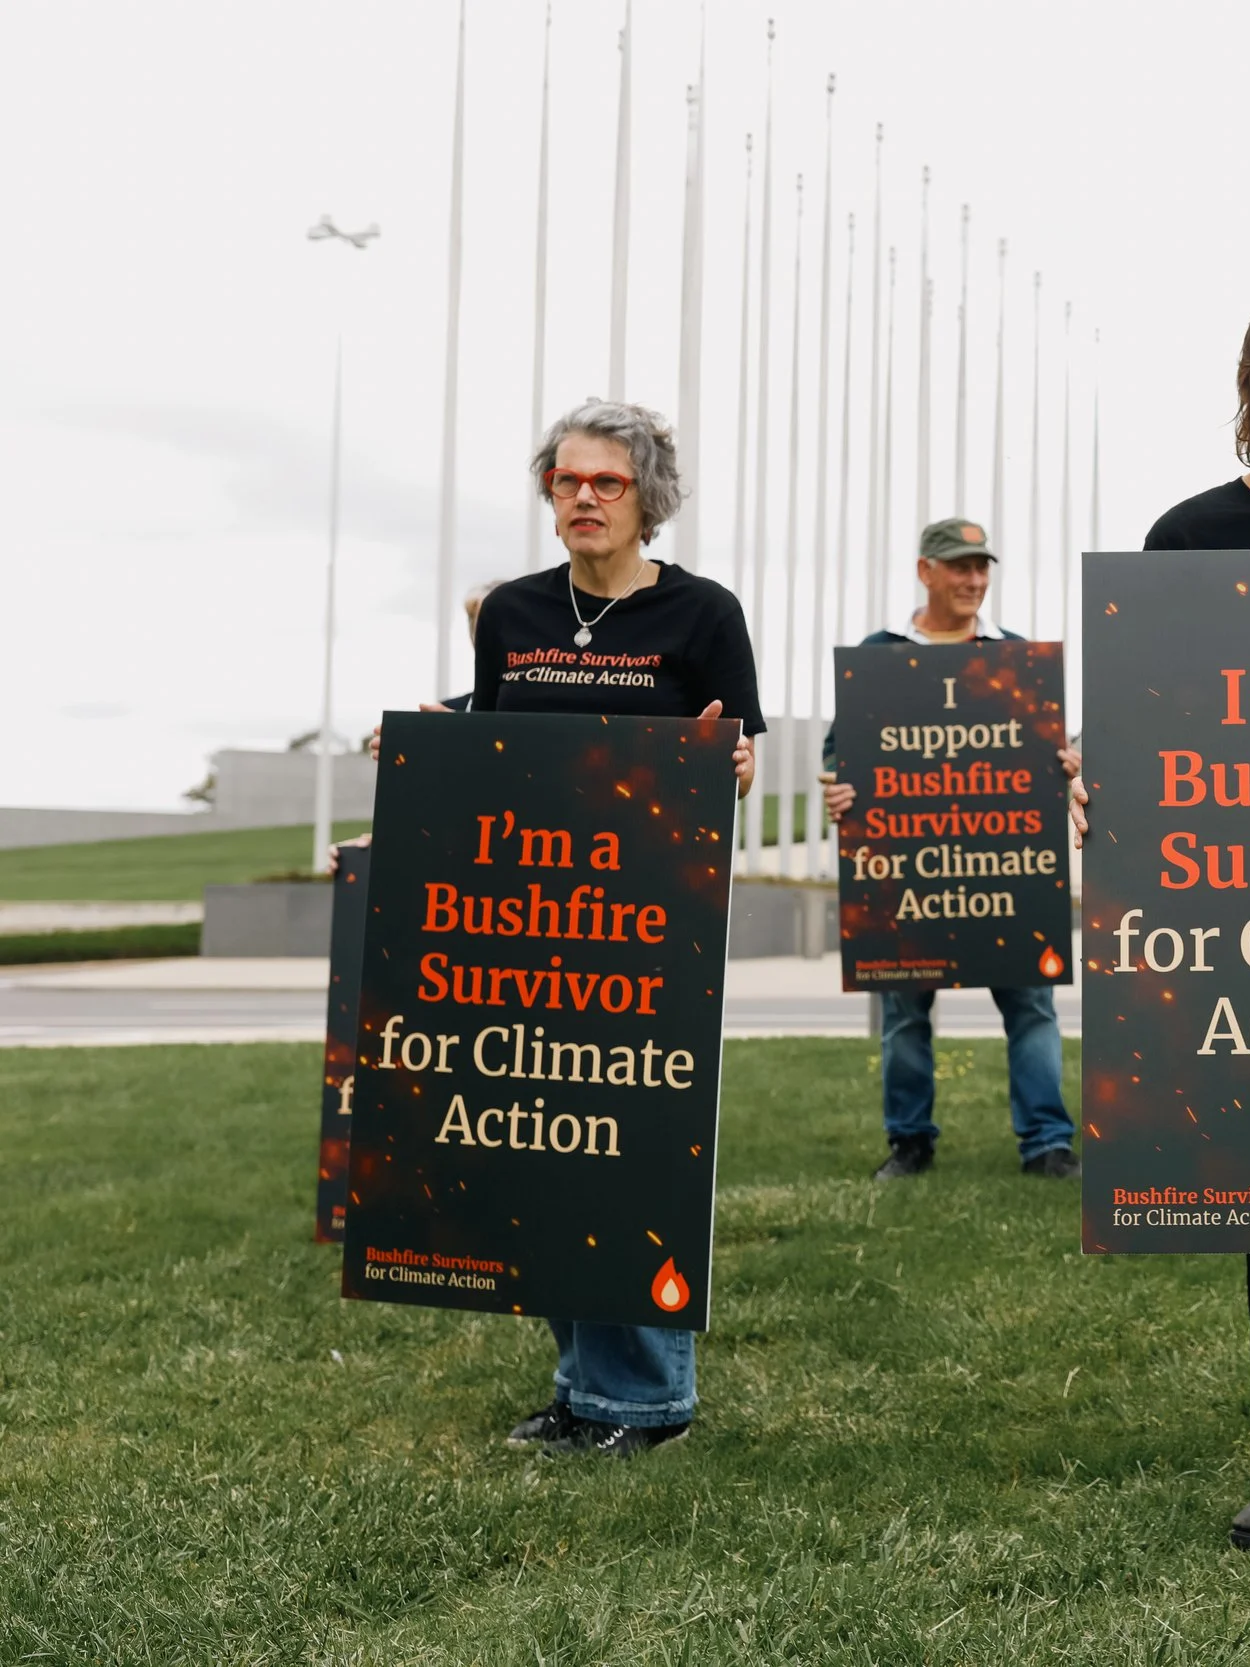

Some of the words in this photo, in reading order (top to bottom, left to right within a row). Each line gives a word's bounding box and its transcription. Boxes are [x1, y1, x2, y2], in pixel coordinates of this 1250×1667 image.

[508, 648, 576, 668] Bushfire
[579, 652, 662, 667] Survivors
[502, 670, 525, 682] or
[526, 667, 594, 684] Climate
[596, 671, 654, 687] Action
[944, 678, 956, 708] I
[881, 719, 1022, 758] support
[875, 762, 1031, 798] Bushfire
[865, 804, 1042, 838] Survivors
[475, 811, 573, 868] I’m
[590, 832, 620, 870] a
[854, 846, 907, 880] for
[916, 844, 1056, 878] Climate
[423, 883, 666, 943] Bushfire
[896, 886, 1014, 919] Action
[1113, 909, 1219, 972] for
[418, 953, 663, 1014] Survivor
[379, 1015, 459, 1072] for
[474, 1024, 694, 1089] Climate
[435, 1095, 620, 1156] Action
[1114, 1187, 1198, 1205] Bushfire
[1113, 1209, 1141, 1225] for
[1147, 1209, 1221, 1225] Climate
[366, 1247, 428, 1266] Bushfire
[432, 1254, 504, 1272] Survivors
[366, 1263, 386, 1279] for
[389, 1267, 445, 1285] Climate
[448, 1273, 495, 1290] Action
